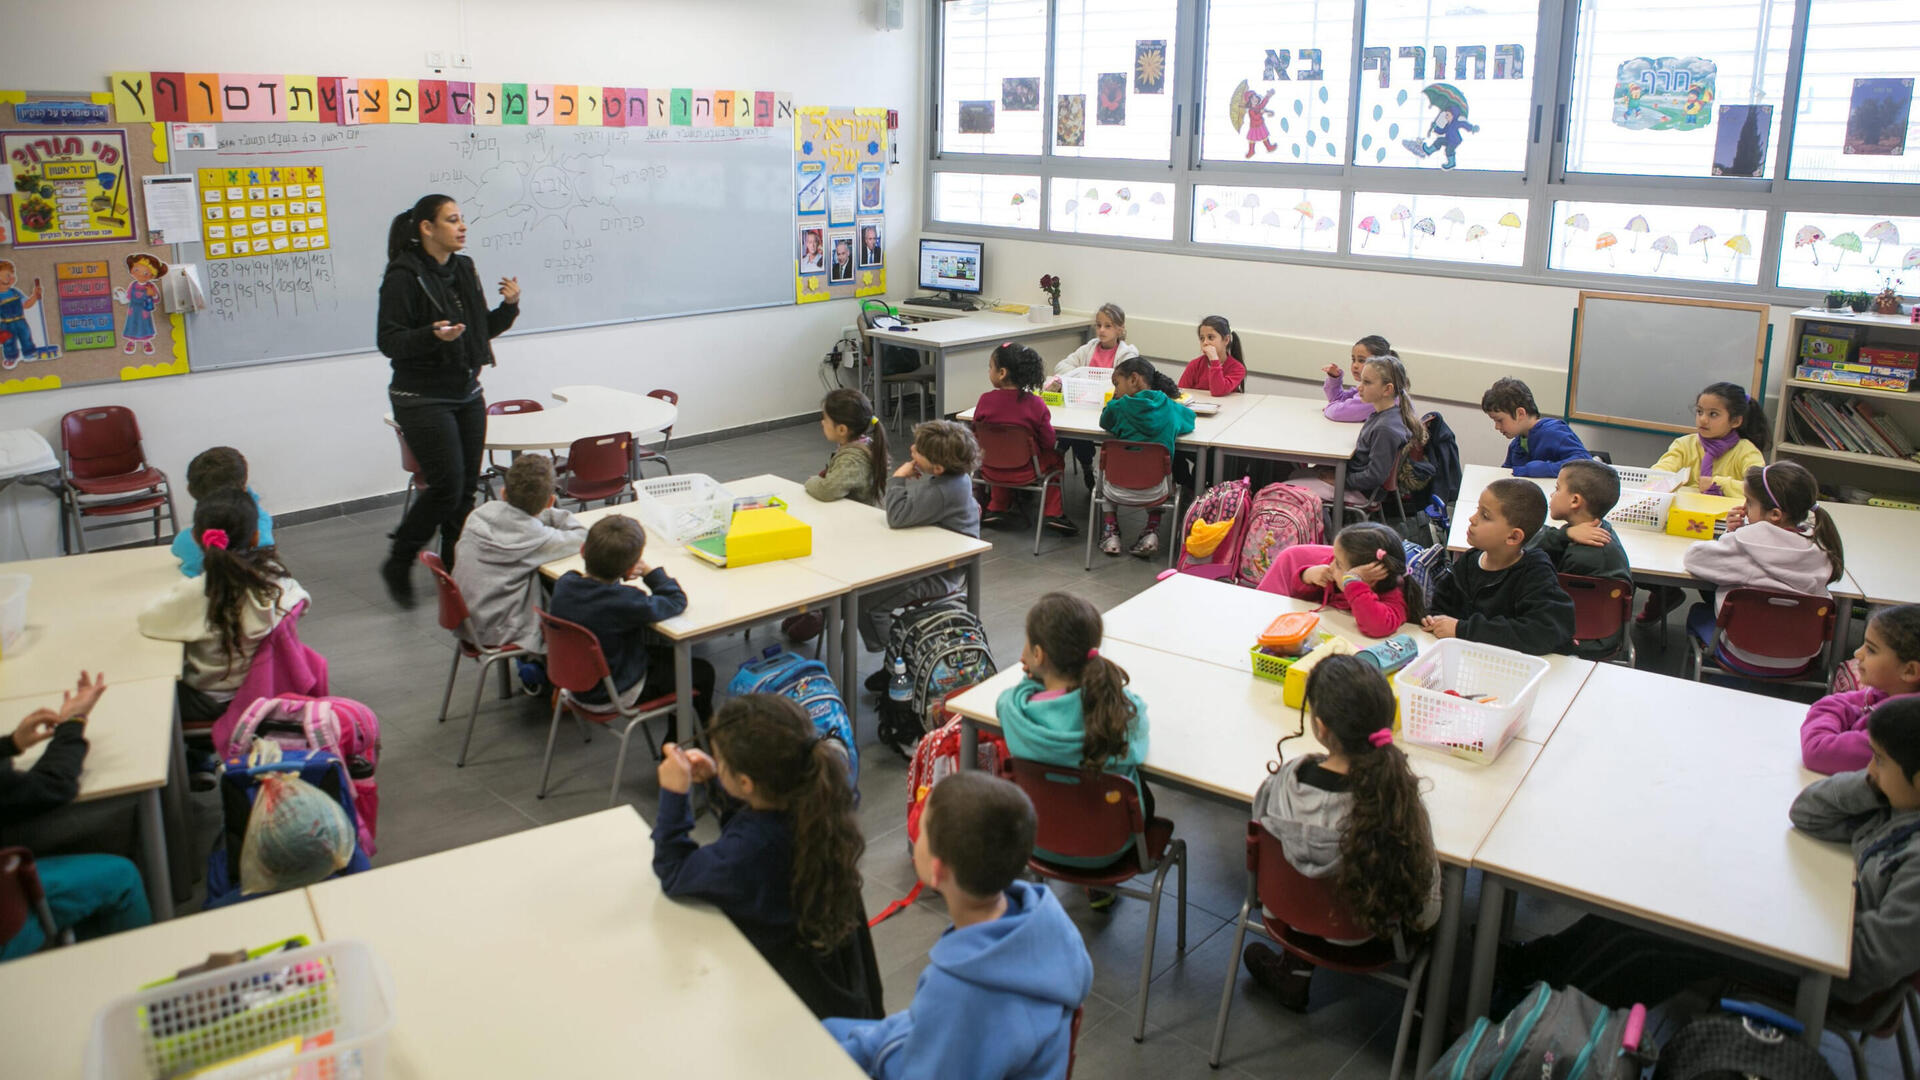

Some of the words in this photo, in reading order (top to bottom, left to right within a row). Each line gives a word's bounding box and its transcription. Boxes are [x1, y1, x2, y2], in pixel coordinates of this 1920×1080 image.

[1262, 48, 1324, 81] בא
[1364, 44, 1525, 89] החורף
[120, 78, 146, 116] ץ
[155, 77, 179, 113] ף
[223, 84, 250, 111] ם
[289, 86, 313, 112] ת
[363, 88, 381, 113] צ
[394, 87, 412, 112] פ
[423, 88, 441, 115] ע
[485, 91, 496, 115] נ
[505, 91, 525, 116] מ
[534, 88, 549, 117] ל
[559, 93, 574, 116] כ
[588, 95, 597, 111] י
[603, 96, 622, 118] ט
[629, 96, 645, 118] ח
[680, 96, 687, 117] ו
[695, 97, 710, 117] ה
[741, 97, 750, 117] ג
[656, 97, 664, 118] ז
[718, 98, 730, 118] ד
[757, 99, 769, 119] ב
[778, 99, 792, 119] א
[810, 112, 880, 142] ישראל
[91, 140, 119, 165] מי
[822, 144, 860, 172] שלי
[210, 262, 228, 278] 88
[235, 263, 250, 277] 94
[254, 260, 269, 275] 94
[210, 281, 230, 296] 89
[237, 283, 253, 298] 95
[256, 280, 273, 294] 95
[214, 297, 233, 309] 90
